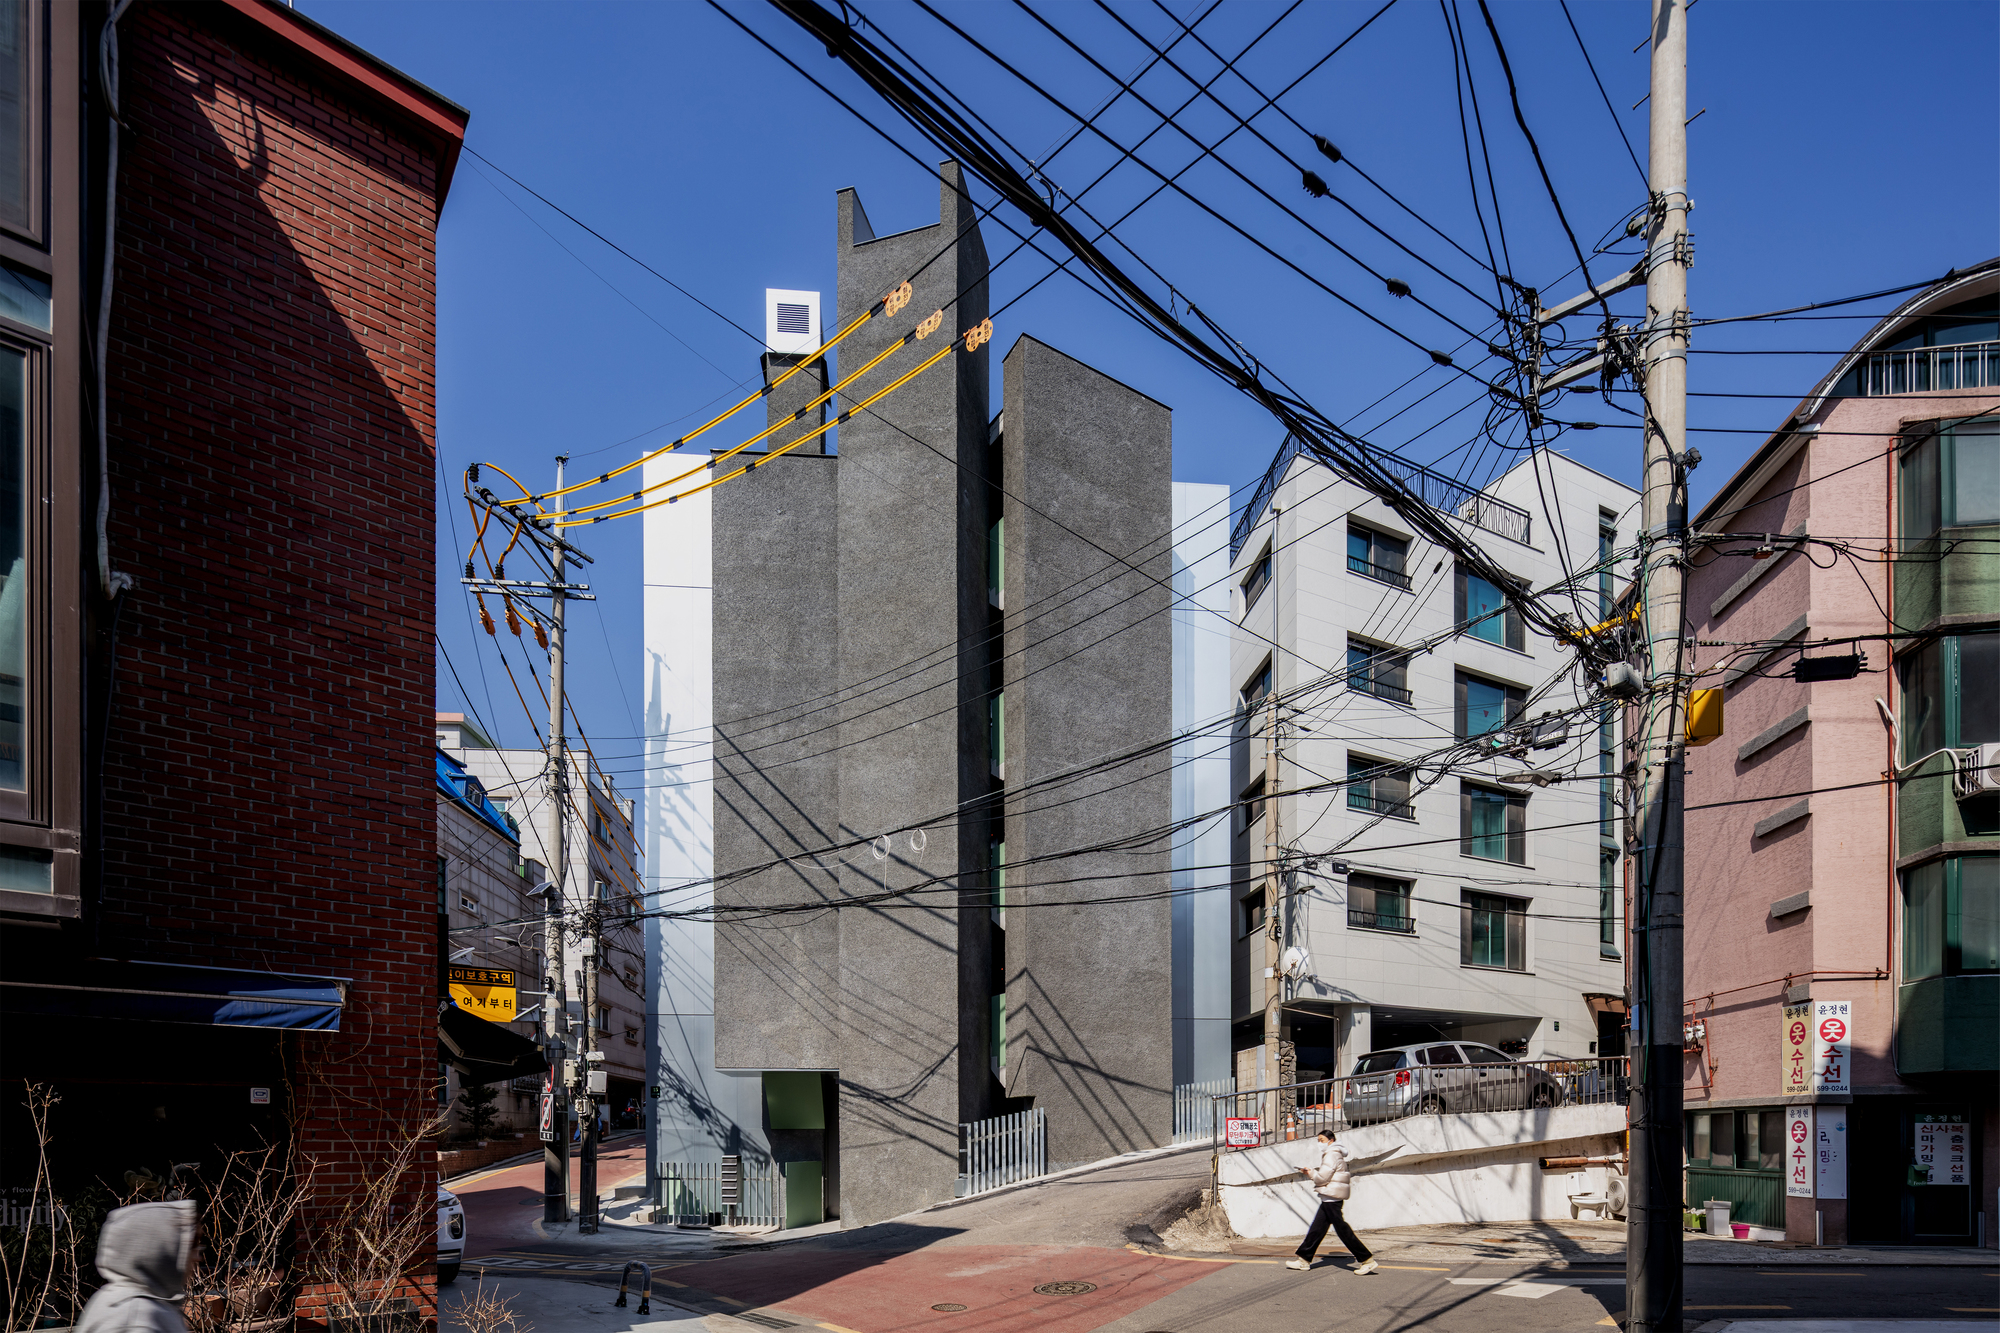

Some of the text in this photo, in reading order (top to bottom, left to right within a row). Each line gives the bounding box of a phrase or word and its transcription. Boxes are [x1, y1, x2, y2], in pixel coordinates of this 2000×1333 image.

[463, 996, 512, 1010] 여기부터
[1818, 1004, 1848, 1015] 윤정현
[1786, 1085, 1809, 1093] 599-0244
[1789, 1108, 1809, 1118] 윤정현
[11, 1186, 47, 1194] flowrs
[1788, 1186, 1811, 1195] 599-0244
